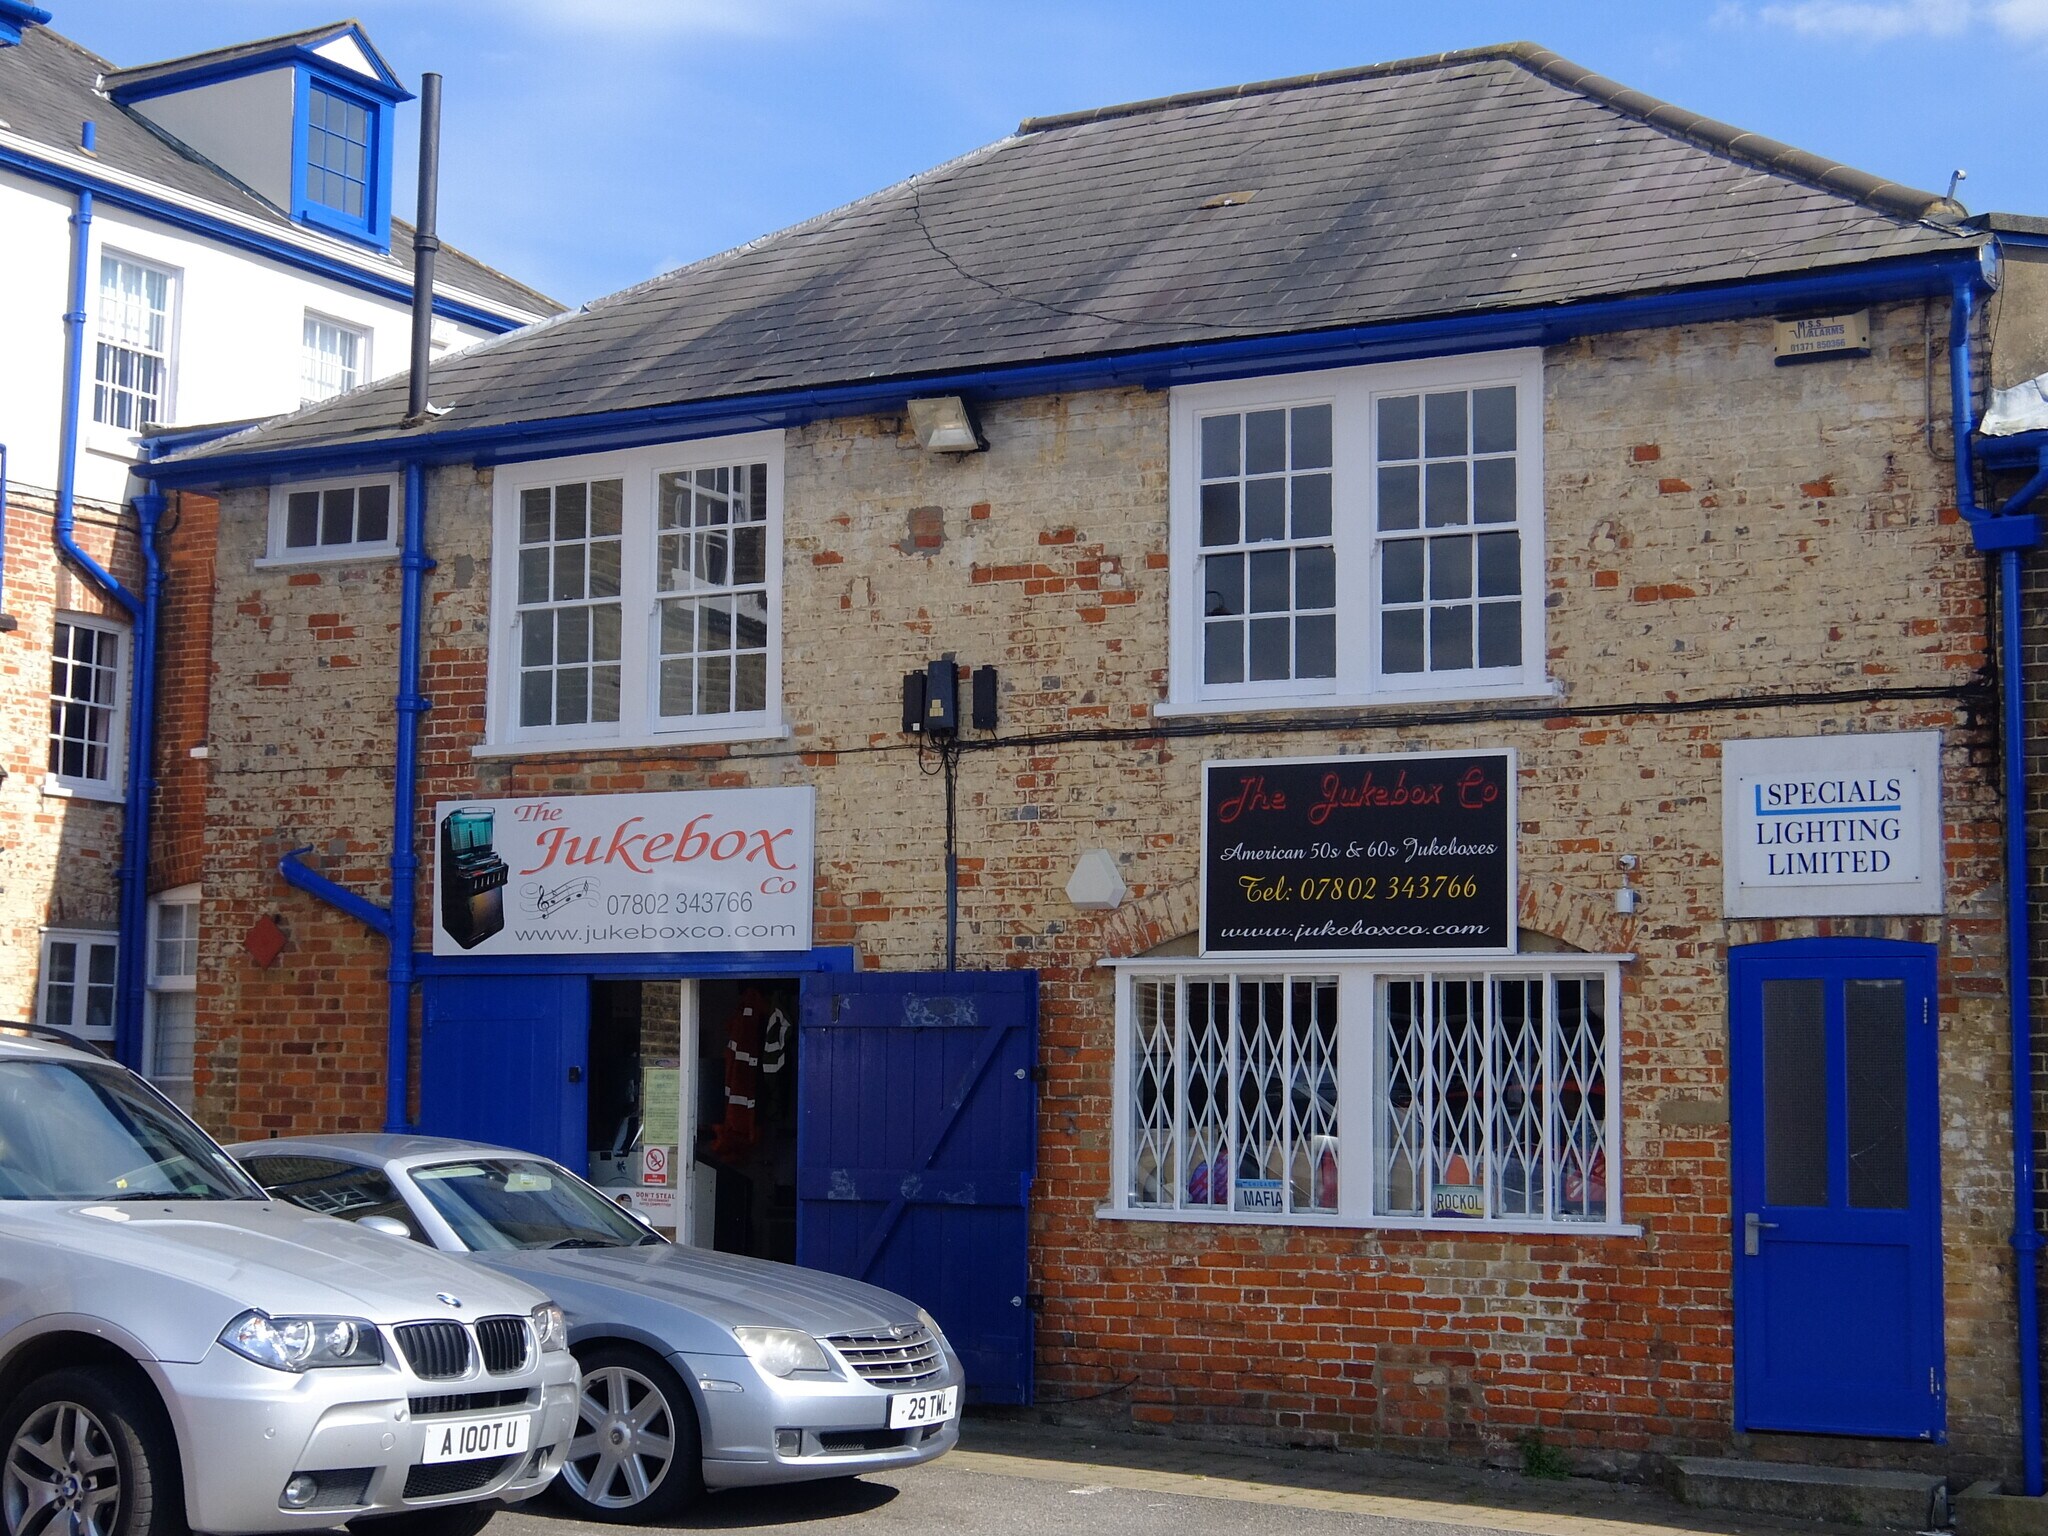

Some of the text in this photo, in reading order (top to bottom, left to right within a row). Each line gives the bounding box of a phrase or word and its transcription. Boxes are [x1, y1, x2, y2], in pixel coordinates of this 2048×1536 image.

[1808, 326, 1845, 338] ALARMS
[1790, 342, 1814, 352] 01371
[1218, 766, 1498, 826] The Jukebox Co
[1768, 778, 1901, 806] SPECIALS
[513, 801, 563, 822] The
[1757, 818, 1901, 845] LIGHTING
[518, 813, 798, 875] Jukebox
[1220, 836, 1498, 863] American 50s & 60s Jukeboxes
[1768, 850, 1891, 876] LIMITED
[759, 876, 797, 895] Co
[1238, 874, 1477, 903] Tel: 07802 343766
[606, 891, 753, 915] 07802 343766
[514, 923, 796, 945] www.jukeboxco.com
[1220, 919, 1490, 943] www.jukeboxco.com
[1243, 1190, 1283, 1207] MAFIA
[1437, 1193, 1484, 1210] ROCKOL
[908, 1393, 947, 1420] 29 TWL
